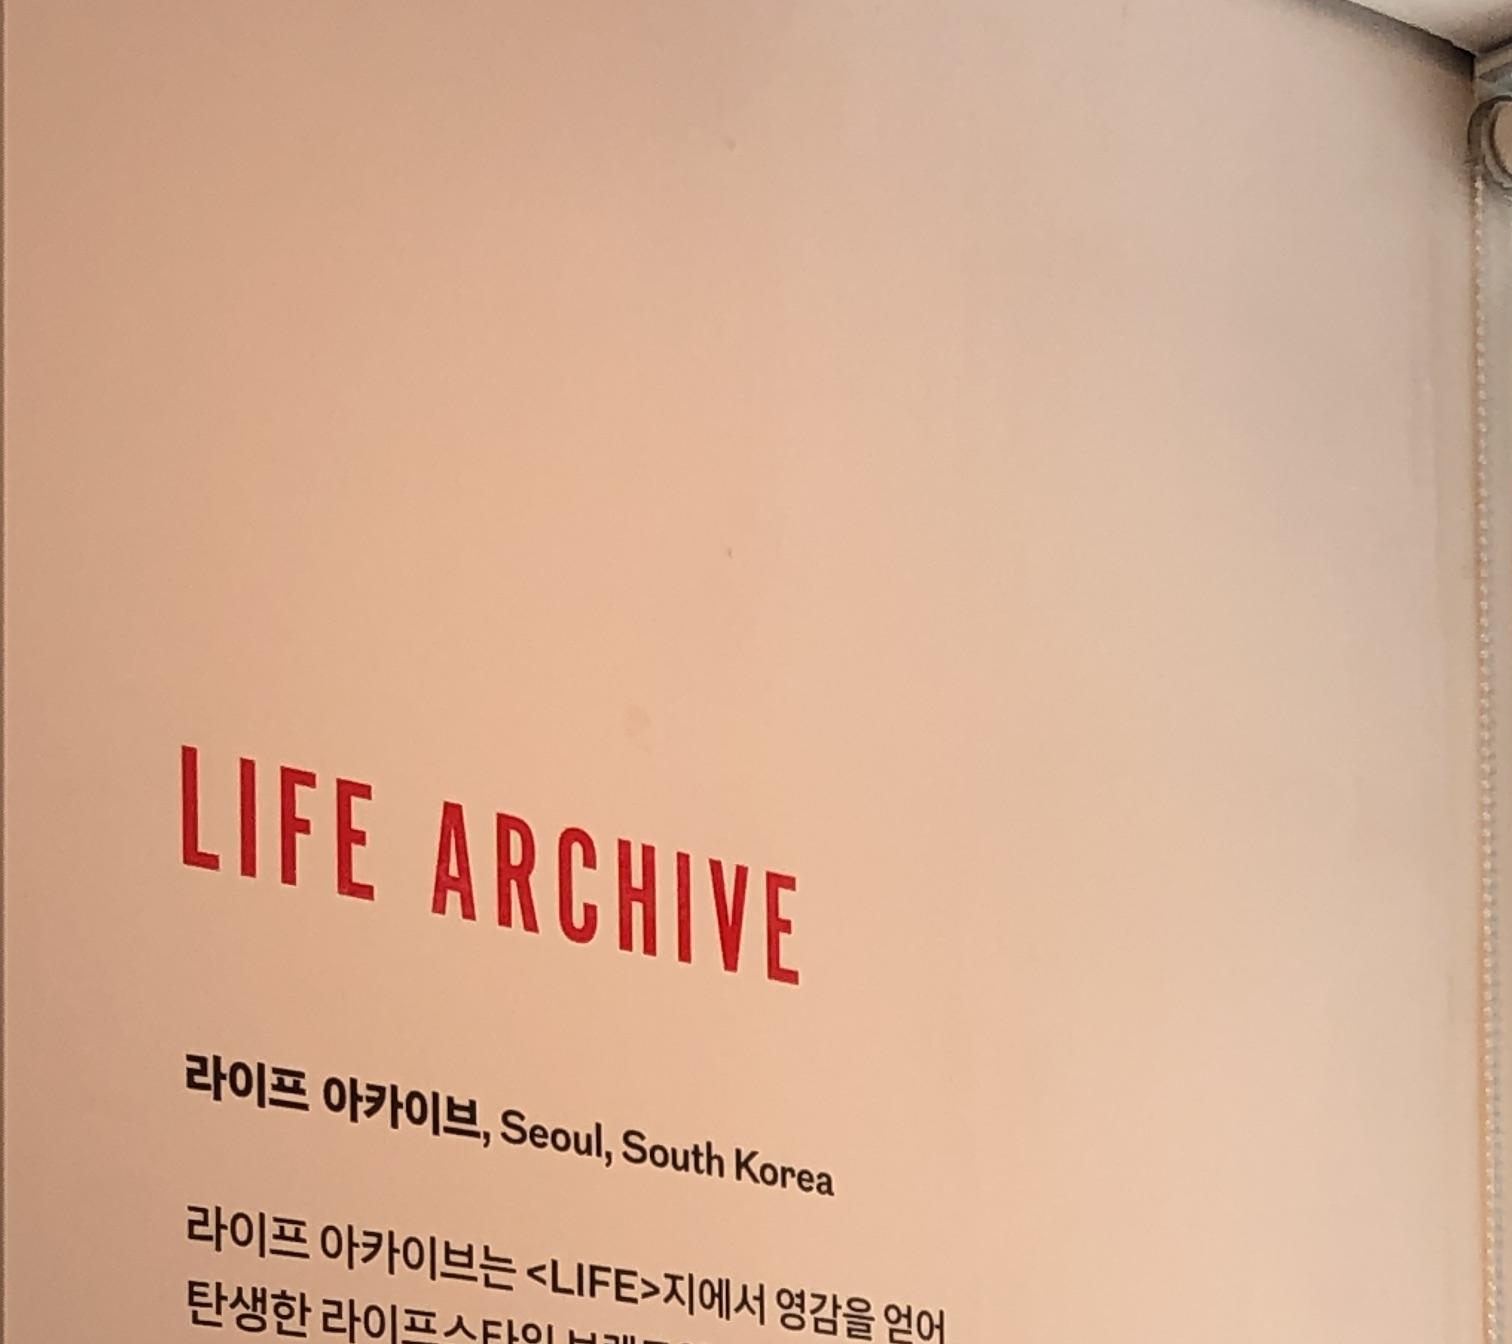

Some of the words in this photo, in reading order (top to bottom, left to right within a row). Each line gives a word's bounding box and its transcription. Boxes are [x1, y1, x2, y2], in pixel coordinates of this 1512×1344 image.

[182, 745, 375, 900] LIFE
[432, 801, 799, 984] ARCHIVE
[186, 1054, 309, 1111] 라이프
[323, 1077, 491, 1148] 아카이브,
[500, 1110, 614, 1168] Seoul,
[622, 1132, 725, 1178] South
[734, 1147, 835, 1198] Korea
[187, 1205, 309, 1259] 라이프
[320, 1224, 516, 1291] 아카이브는
[526, 1258, 766, 1325] <LIFE>지에서
[776, 1287, 875, 1341] 영감을
[187, 1280, 312, 1338] 탄생한
